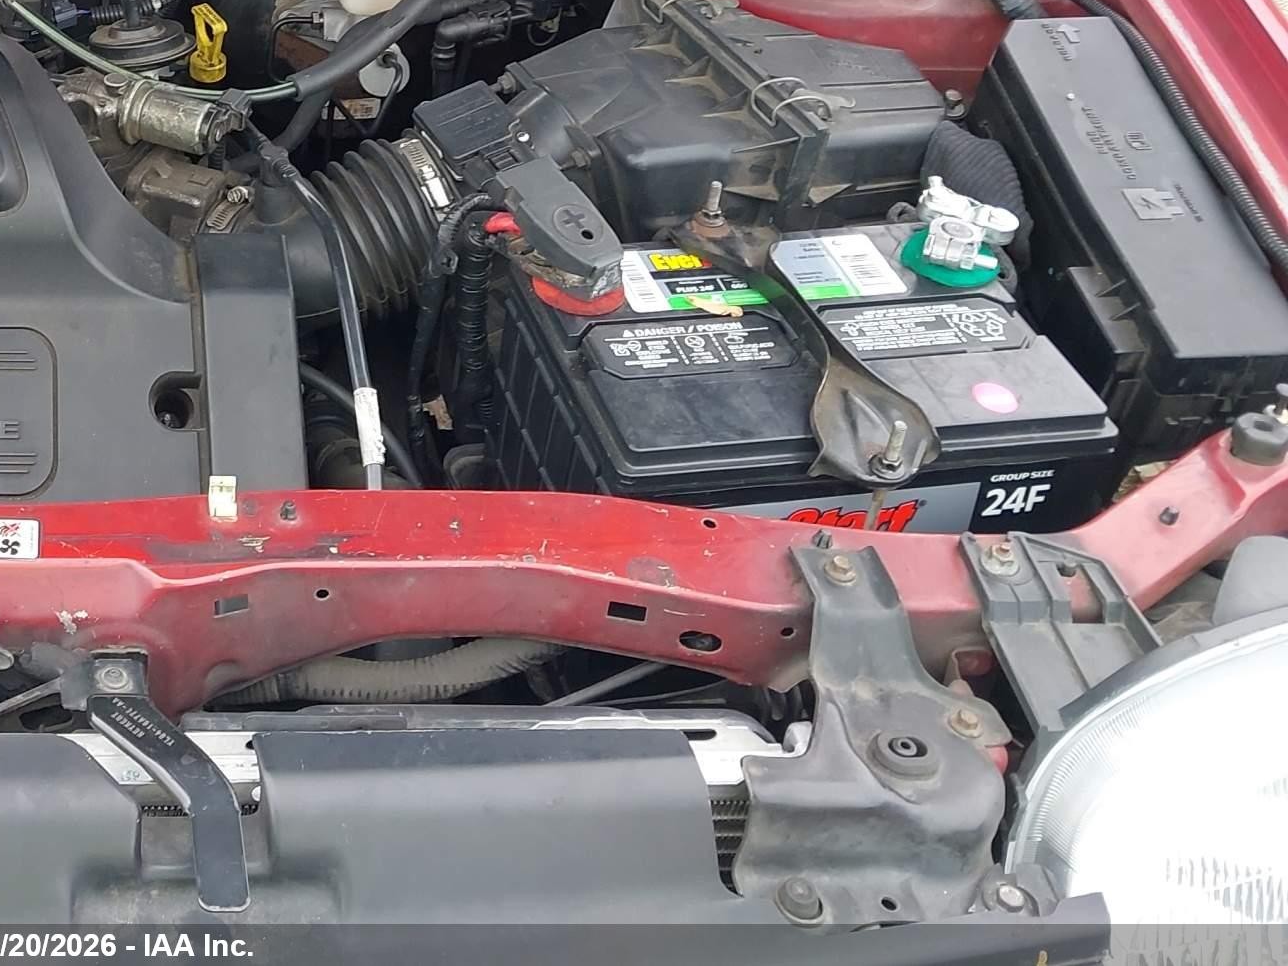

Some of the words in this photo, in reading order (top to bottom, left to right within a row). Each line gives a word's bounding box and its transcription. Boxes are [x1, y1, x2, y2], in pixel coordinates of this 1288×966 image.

[634, 326, 686, 336] DANGER
[696, 322, 743, 333] POISON
[990, 472, 1029, 482] GROUP
[1030, 470, 1055, 479] SIZE
[981, 484, 1051, 516] 24F
